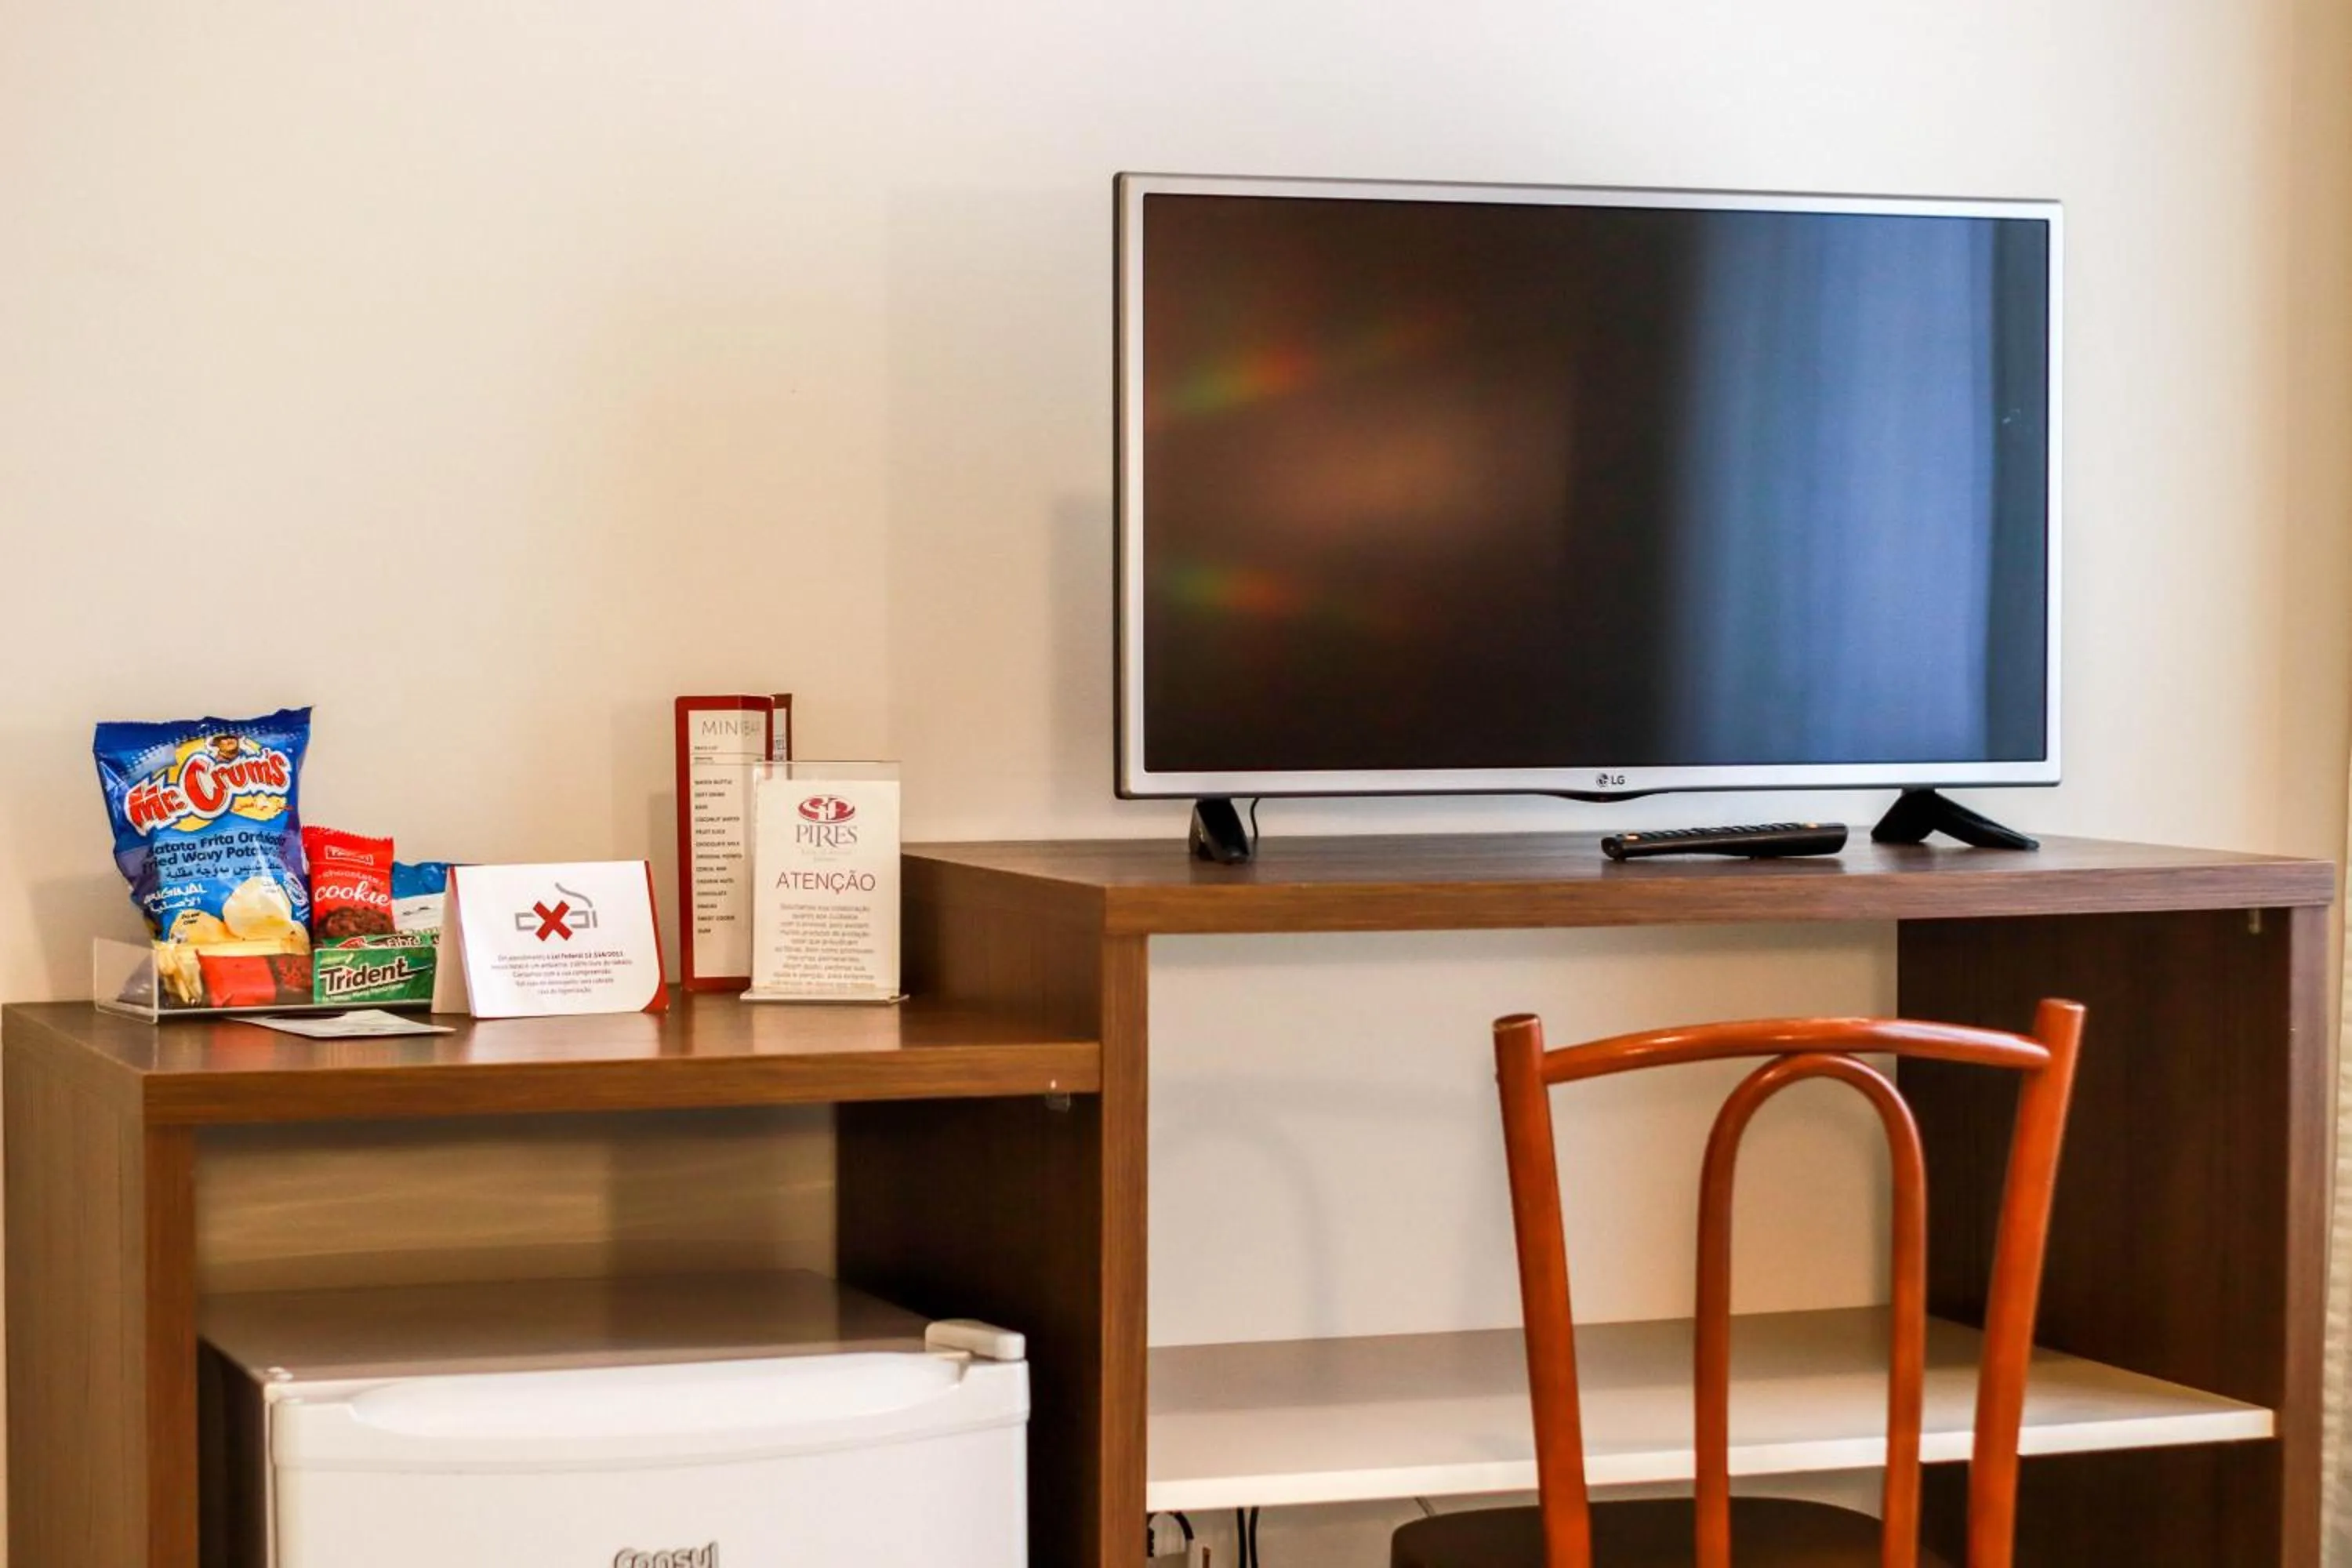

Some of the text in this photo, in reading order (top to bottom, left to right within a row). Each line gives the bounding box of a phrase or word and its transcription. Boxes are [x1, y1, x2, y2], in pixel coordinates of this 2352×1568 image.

[127, 750, 290, 829] Mr. Crum's
[1610, 775, 1626, 786] LG
[200, 834, 234, 849] Frita
[796, 824, 858, 848] PIRES
[182, 848, 223, 865] Wavy
[226, 844, 289, 860] Pota
[314, 880, 390, 907] cookie
[775, 869, 877, 895] ATENÇÃO
[318, 956, 416, 994] Trident
